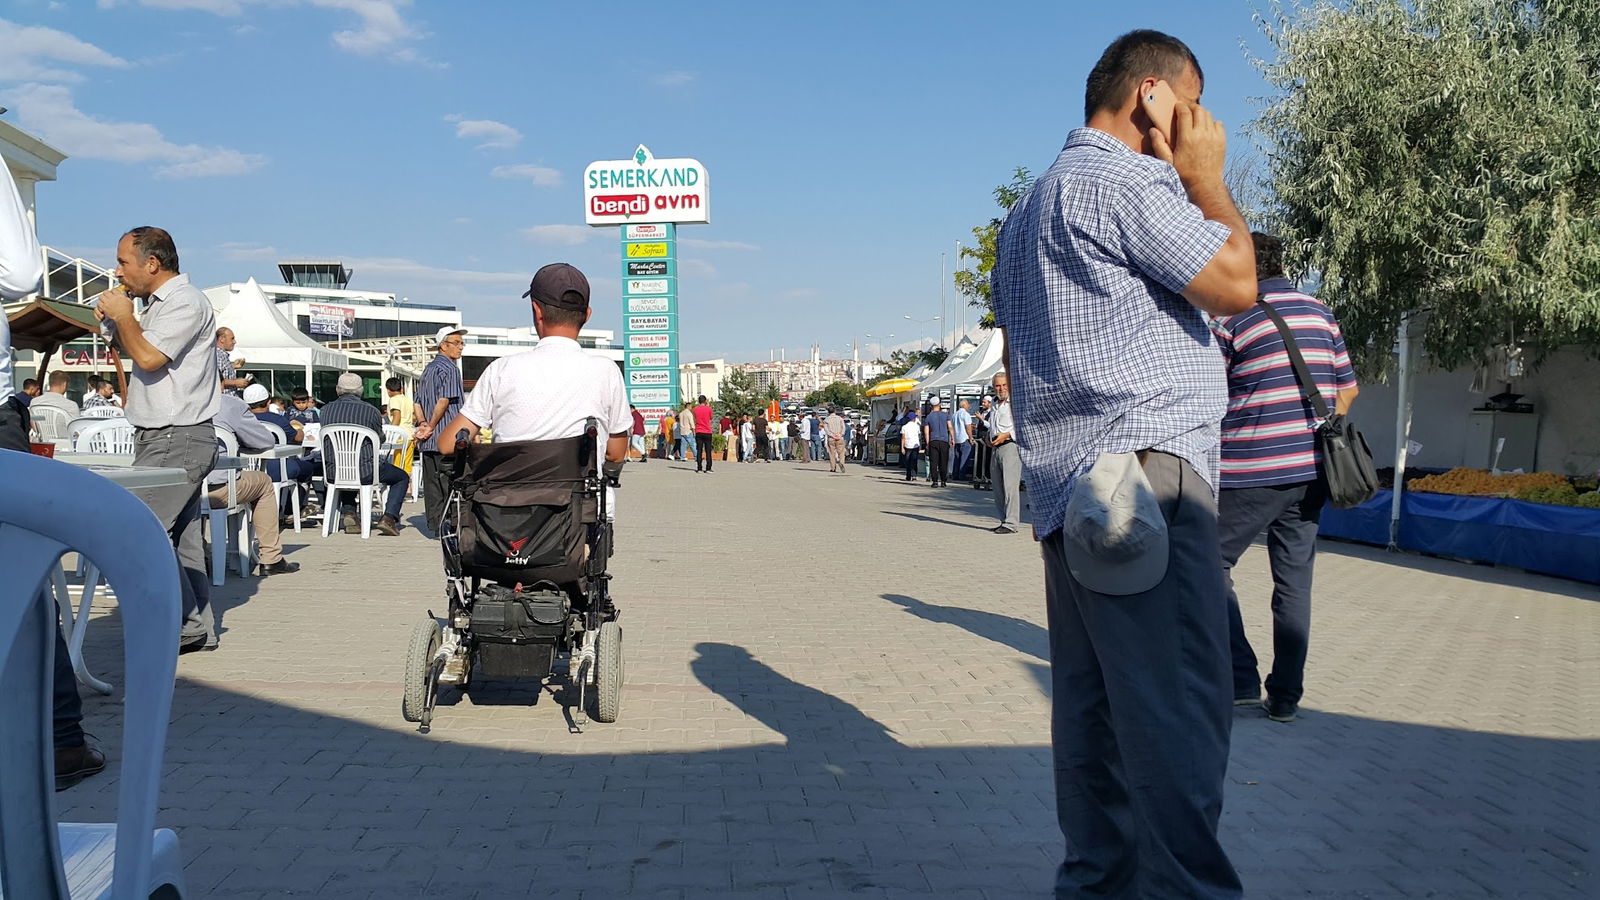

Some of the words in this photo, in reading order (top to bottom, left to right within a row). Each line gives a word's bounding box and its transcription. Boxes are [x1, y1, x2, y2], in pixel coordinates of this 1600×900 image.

[589, 168, 699, 189] SEMERKAND
[593, 195, 647, 214] bendi
[654, 194, 700, 210] avm
